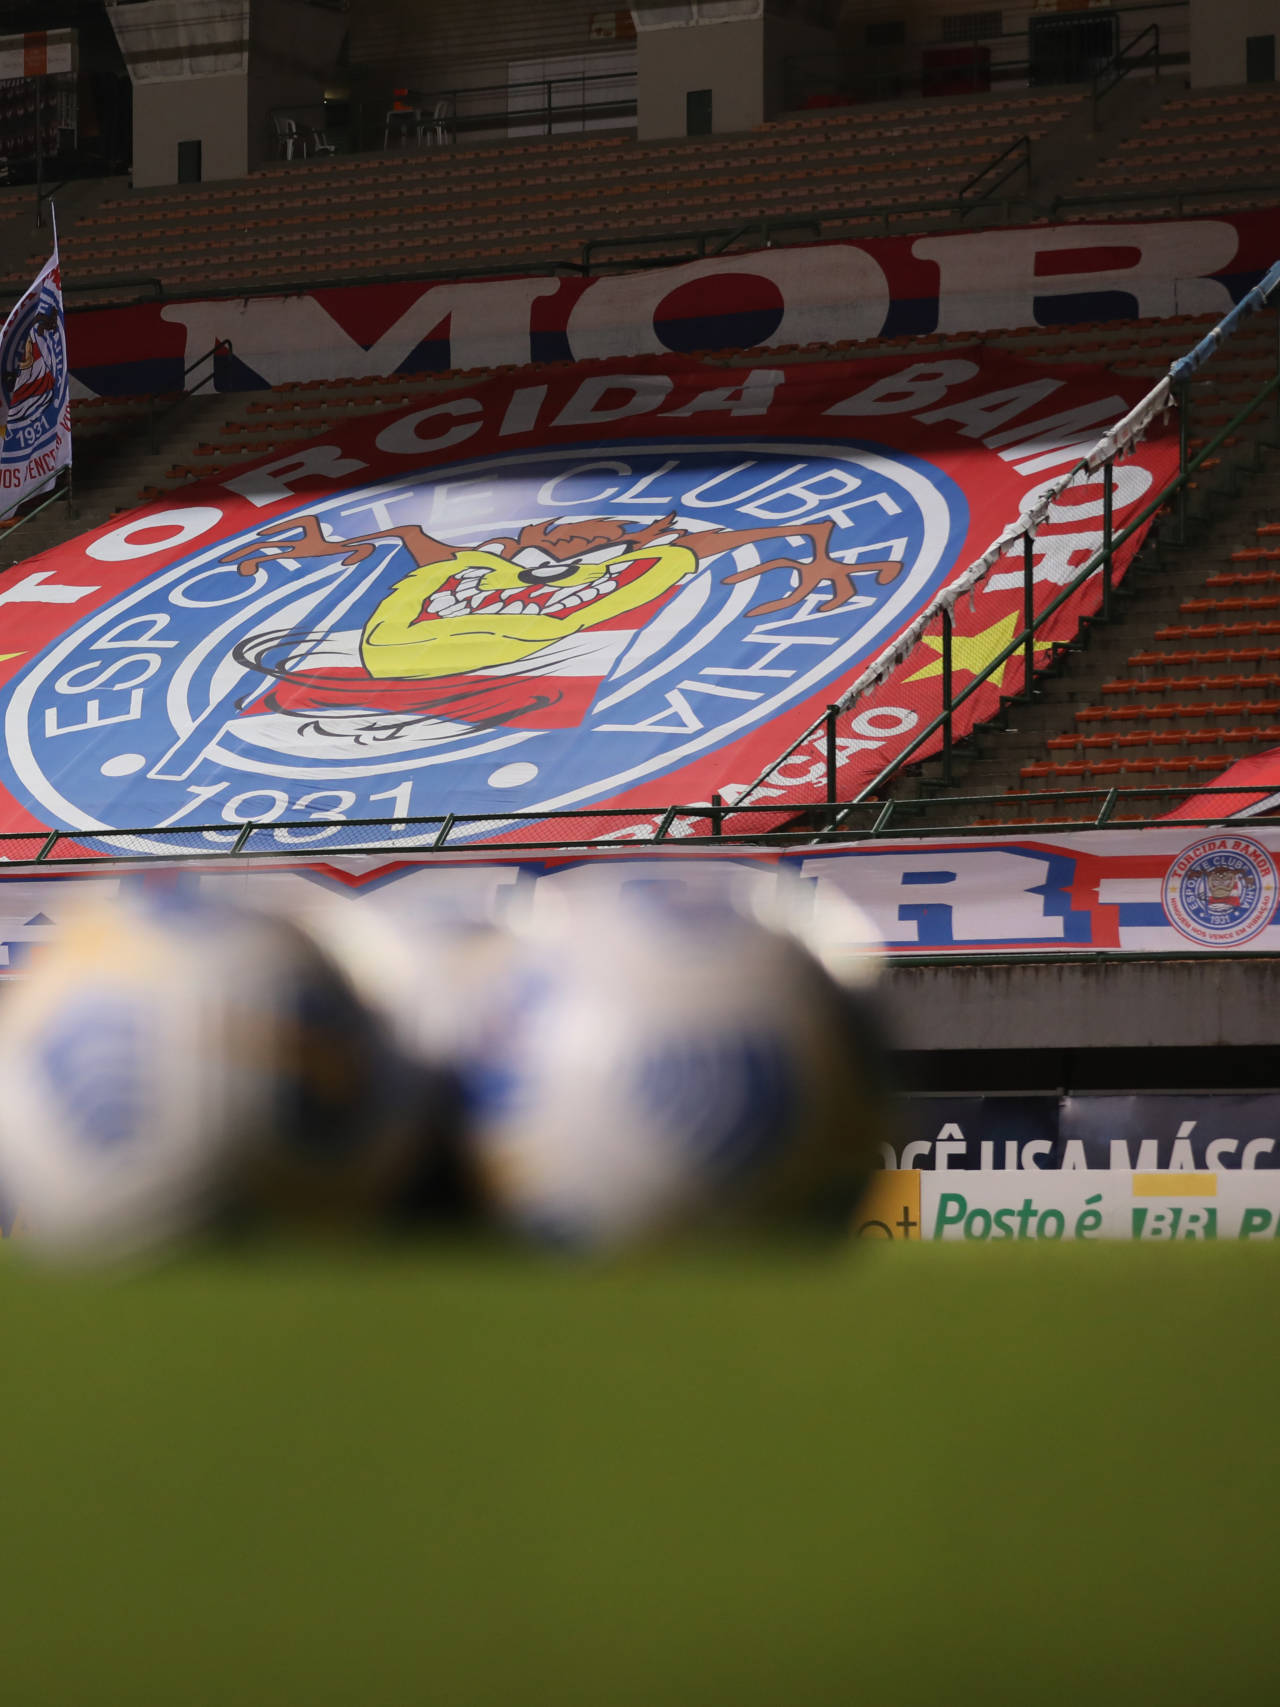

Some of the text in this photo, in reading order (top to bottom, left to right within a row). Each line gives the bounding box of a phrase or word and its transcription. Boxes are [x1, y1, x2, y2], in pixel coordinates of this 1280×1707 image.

[16, 415, 50, 448] 1931
[822, 359, 1154, 594] BAMOR
[535, 460, 903, 547] CLUBE
[147, 780, 413, 844] 1931
[1171, 840, 1272, 878] TORCIDA BAMOR
[1185, 861, 1210, 910] ESPOTE
[1240, 876, 1257, 909] AHIA
[1191, 926, 1207, 938] NOS
[1208, 932, 1234, 940] VENCE
[1235, 927, 1247, 937] EM
[1209, 915, 1231, 925] 1931
[934, 1193, 1065, 1241] Posto
[1075, 1193, 1103, 1241] é
[1139, 1208, 1210, 1241] BR
[1238, 1208, 1280, 1241] P
